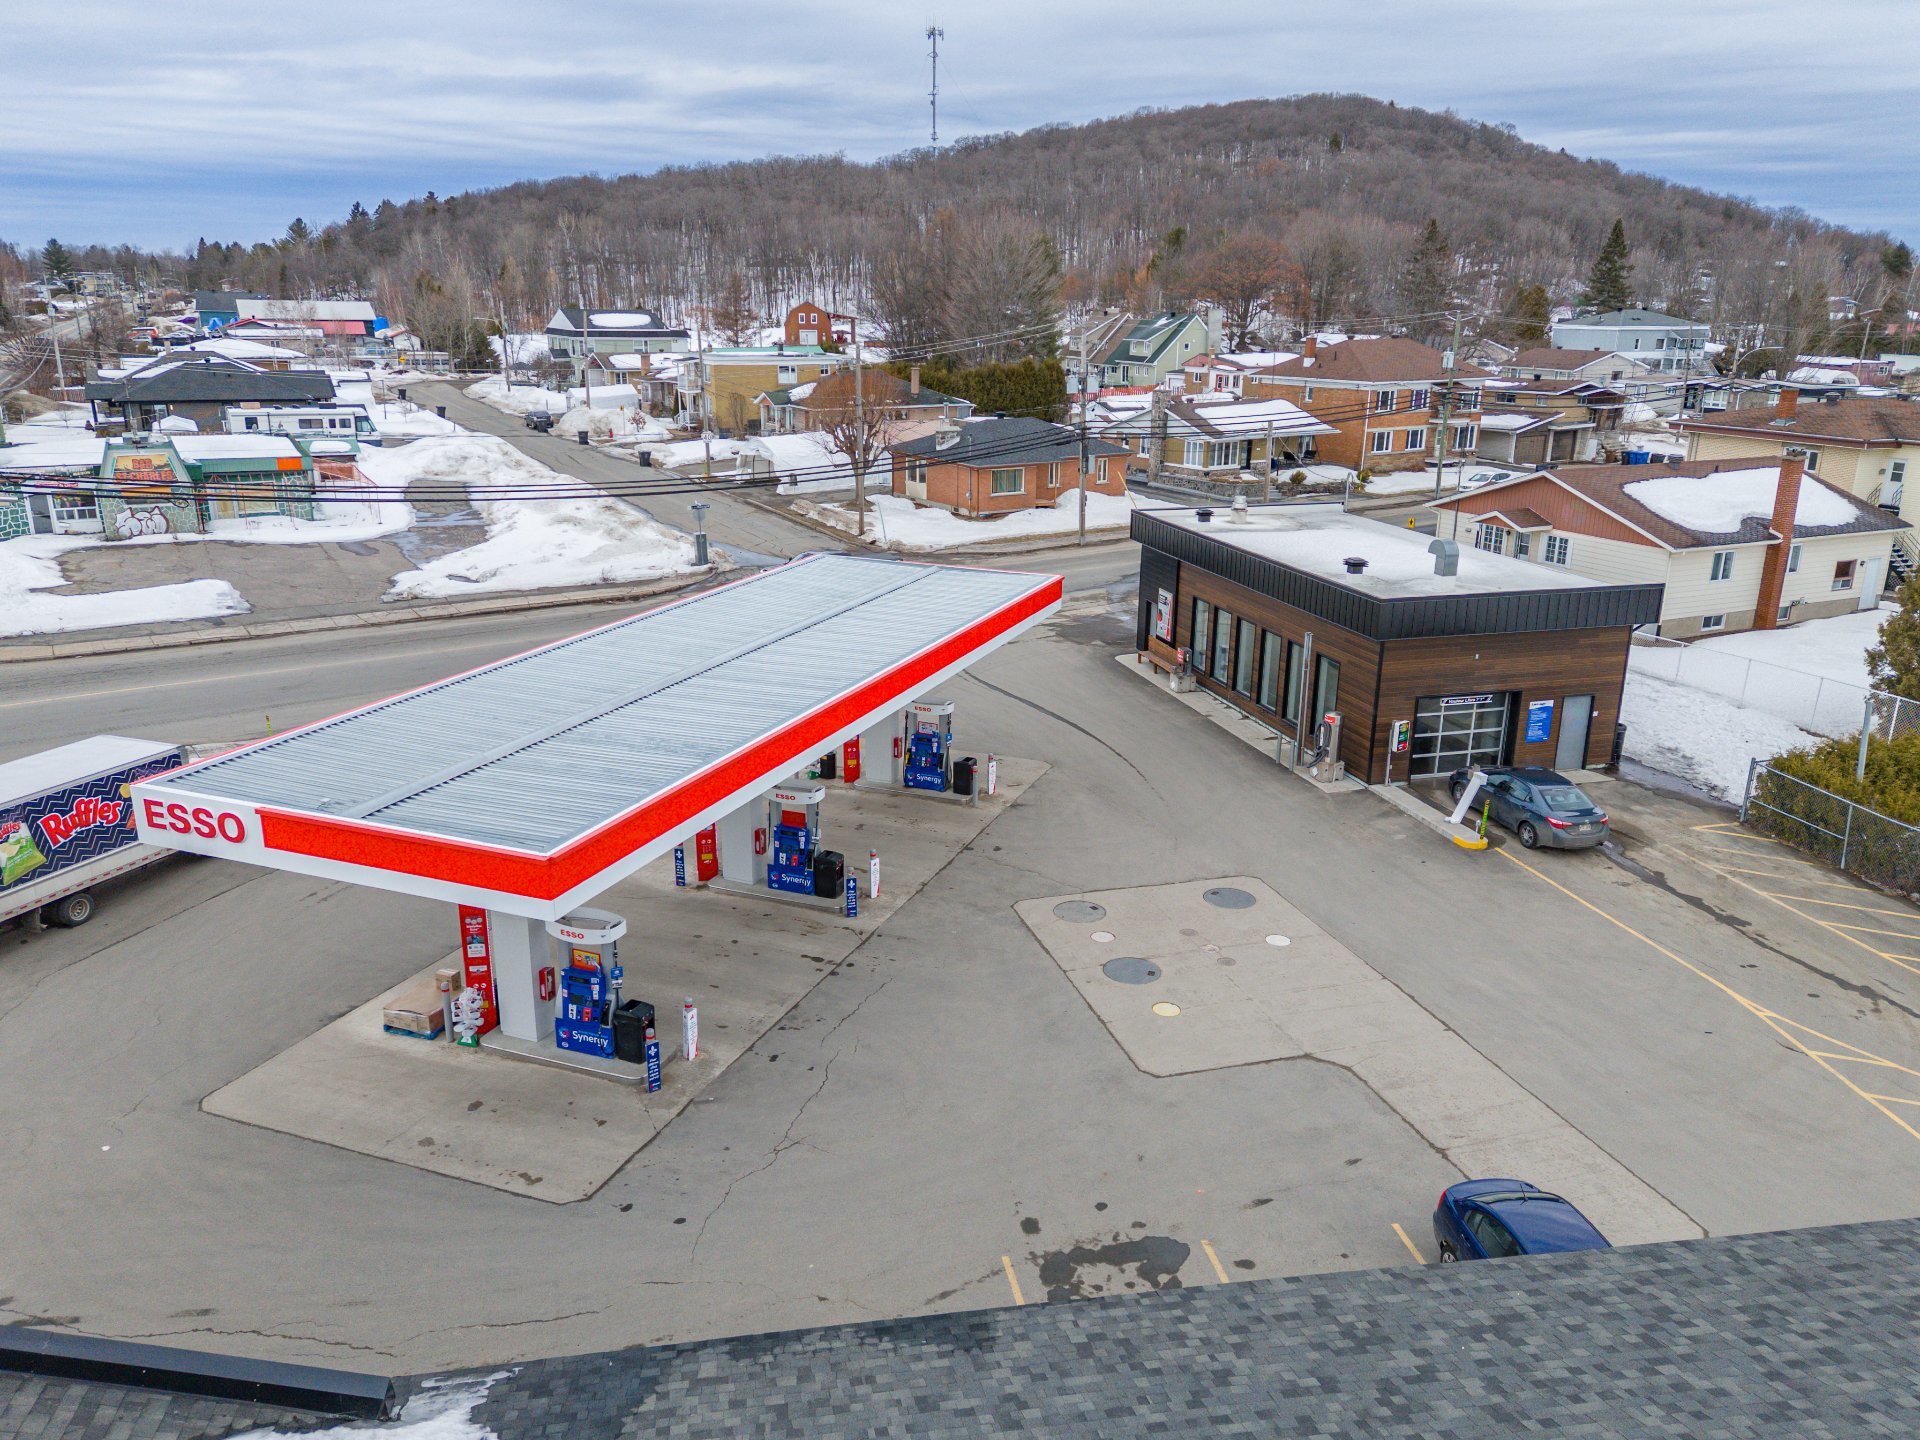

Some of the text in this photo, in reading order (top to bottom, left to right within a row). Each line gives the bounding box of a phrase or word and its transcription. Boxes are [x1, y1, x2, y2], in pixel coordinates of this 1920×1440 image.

[916, 773, 942, 784] Synergy
[775, 793, 796, 801] ESSO
[38, 797, 123, 849] Ruffles
[143, 798, 246, 844] ESSO
[0, 821, 21, 841] uffles
[781, 872, 811, 887] Synergy
[560, 929, 585, 940] ESSO
[572, 1030, 609, 1048] Synergy
